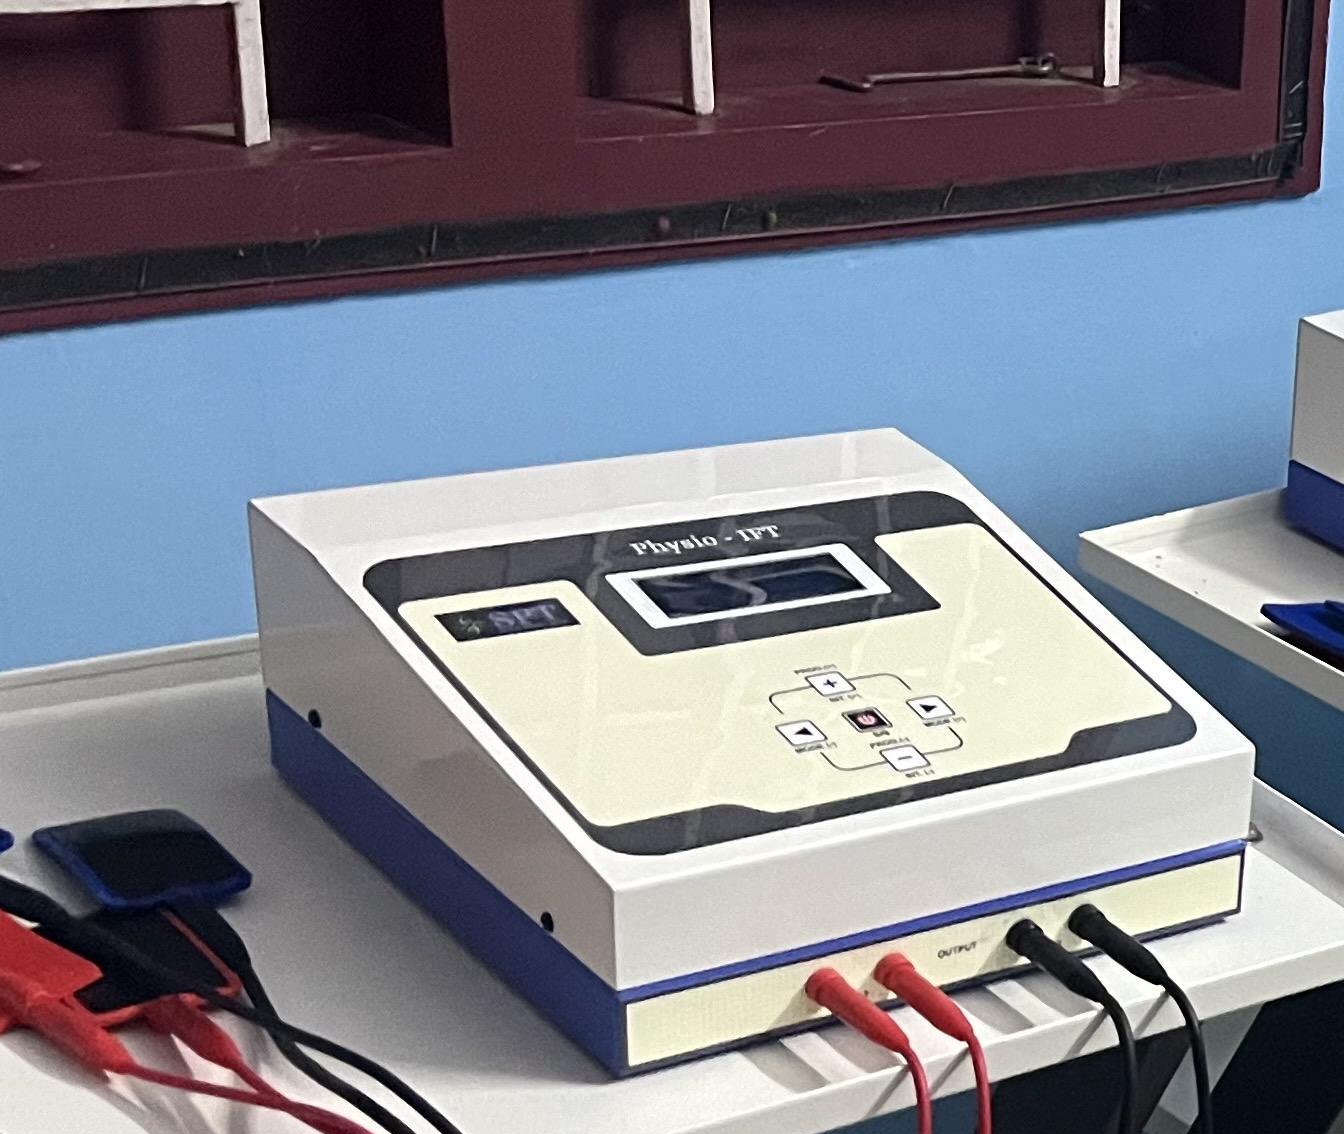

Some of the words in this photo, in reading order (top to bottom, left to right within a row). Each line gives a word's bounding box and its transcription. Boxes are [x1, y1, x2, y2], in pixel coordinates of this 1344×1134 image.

[629, 534, 718, 556] Physio
[735, 524, 781, 542] IFT
[937, 941, 977, 960] OUTPUT
